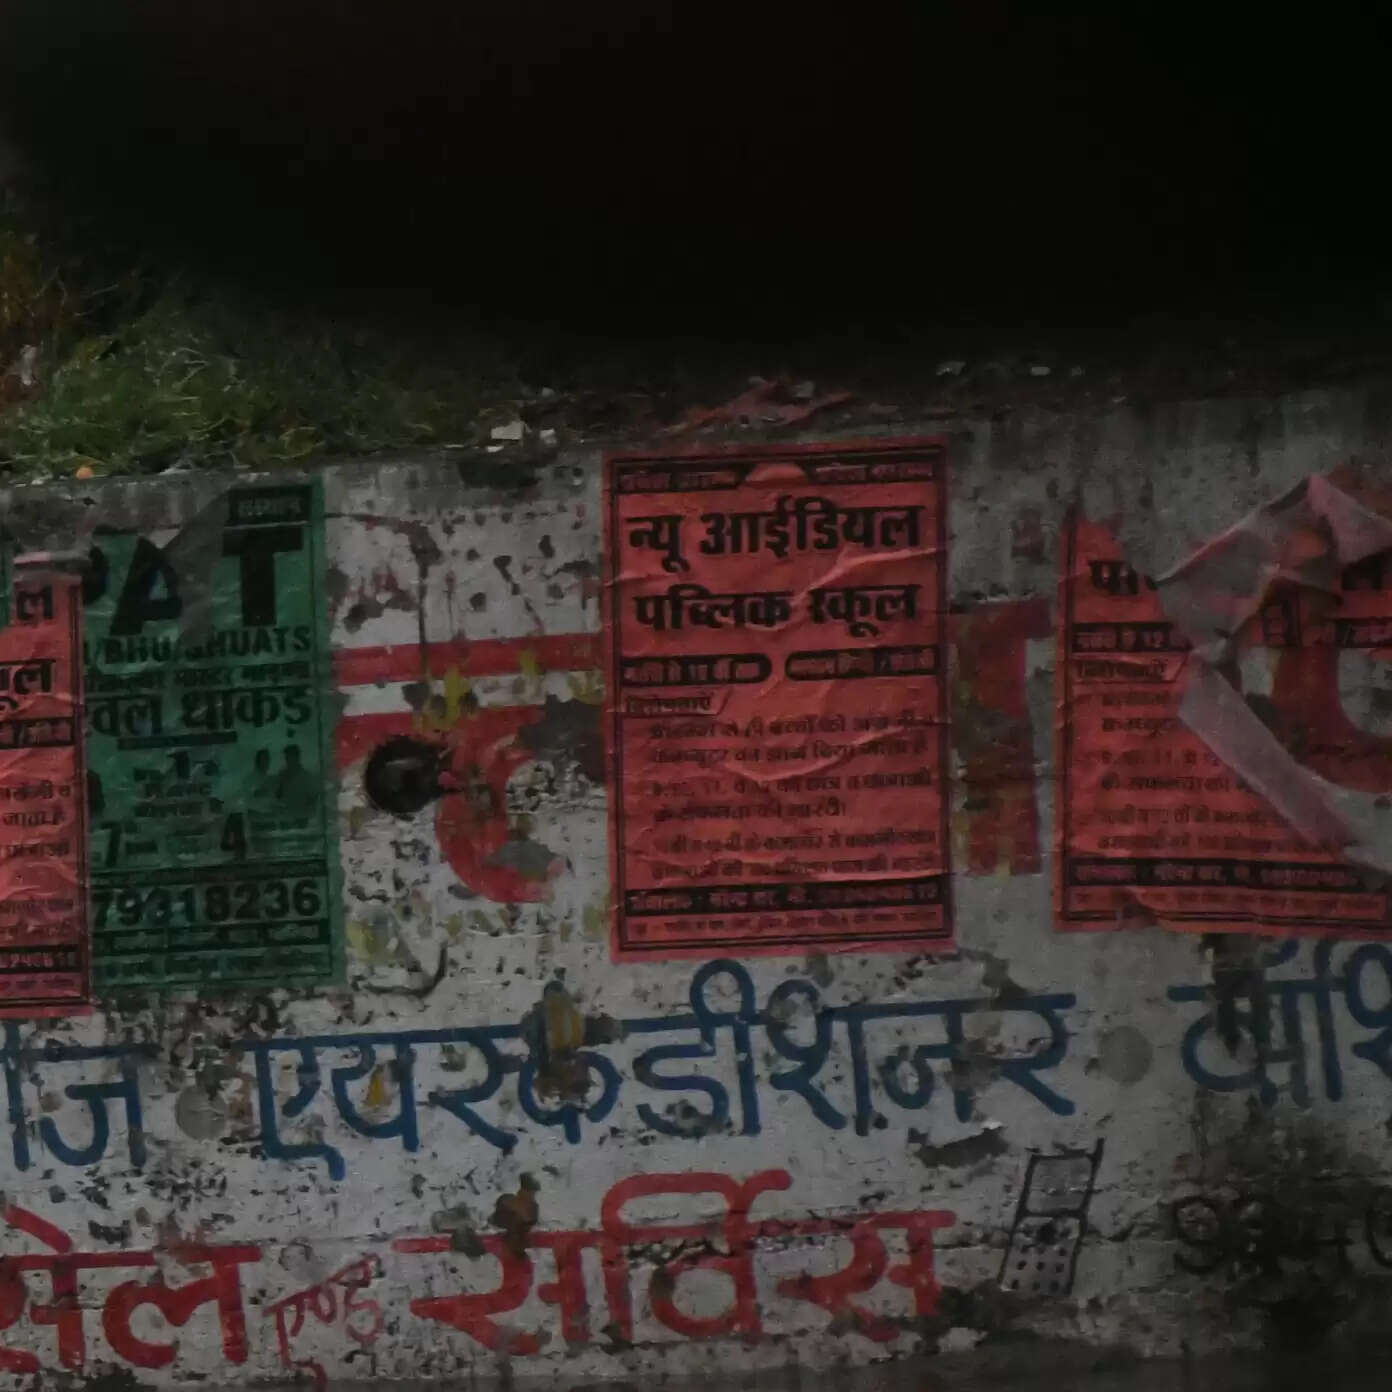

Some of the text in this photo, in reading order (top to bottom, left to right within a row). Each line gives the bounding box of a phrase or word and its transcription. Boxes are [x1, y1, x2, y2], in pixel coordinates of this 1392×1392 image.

[625, 495, 926, 573] न्यू आईडियल
[632, 583, 923, 638] पब्लिक स्कूल
[391, 1167, 957, 1358] सर्विस
